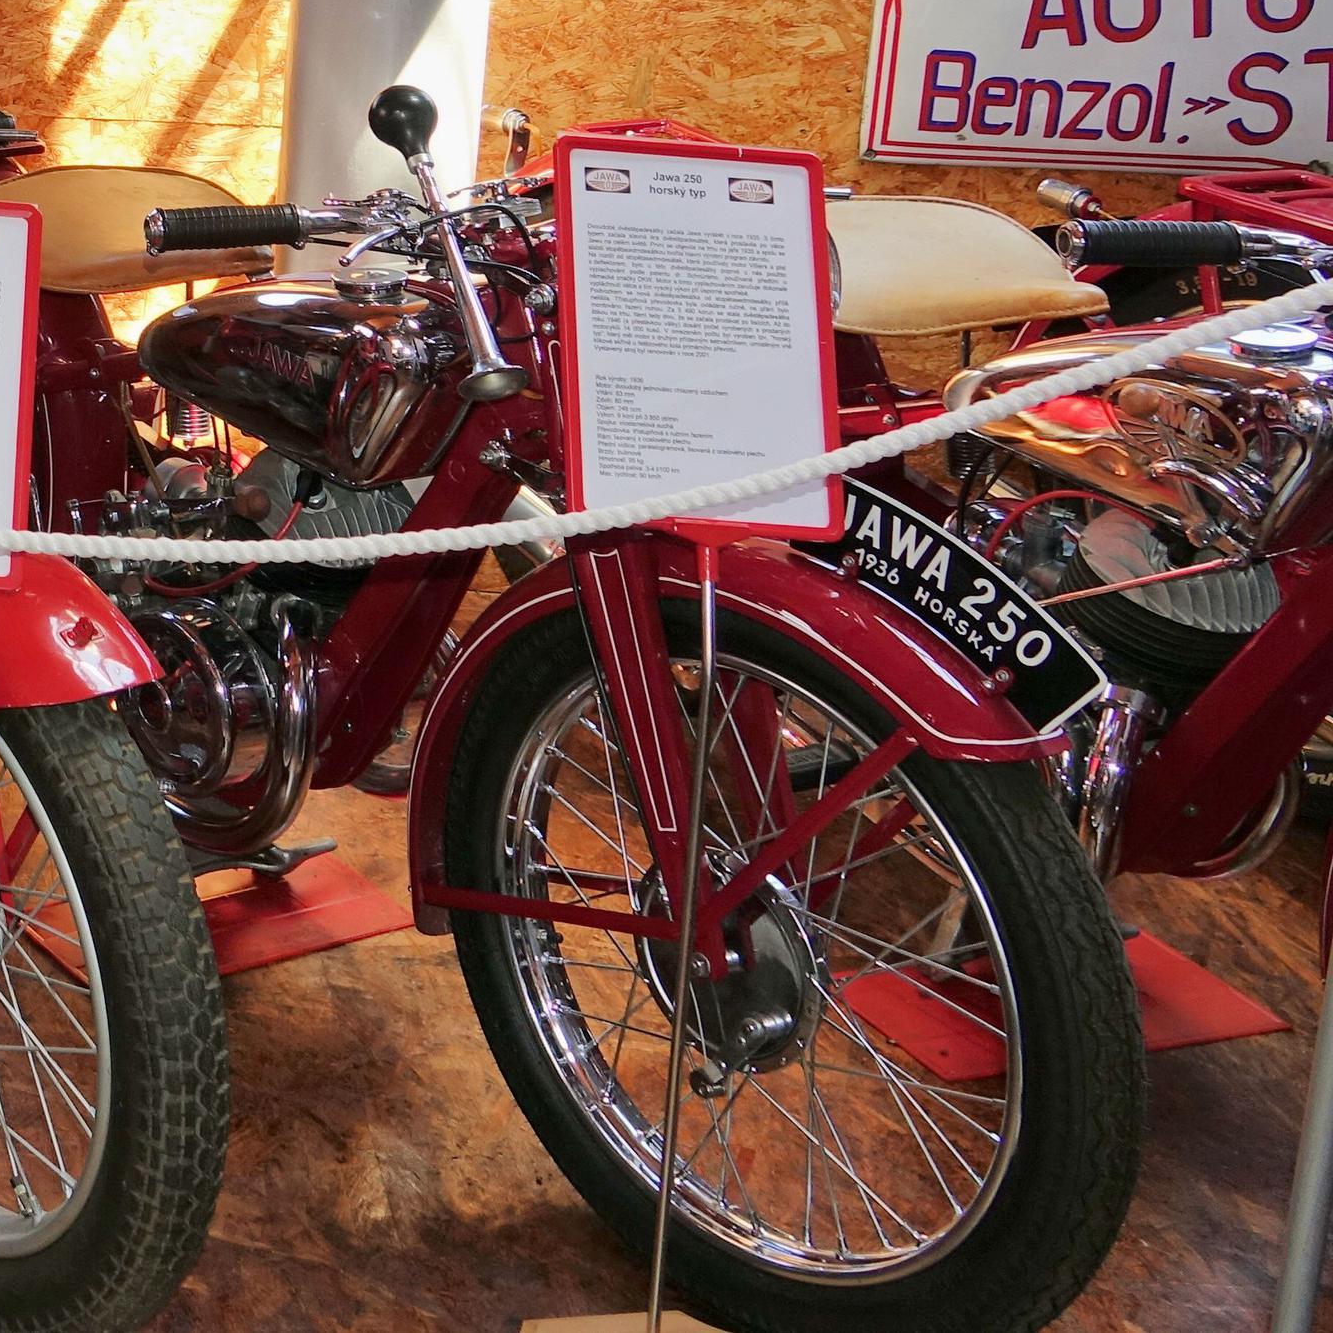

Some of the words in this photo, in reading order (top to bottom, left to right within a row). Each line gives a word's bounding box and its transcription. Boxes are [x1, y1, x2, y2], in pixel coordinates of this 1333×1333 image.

[653, 172, 681, 183] Jawa
[683, 173, 702, 184] 250
[689, 187, 707, 200] typ
[854, 548, 900, 585] 1936
[914, 585, 1002, 662] HORSKÁ
[959, 577, 1052, 667] 250
